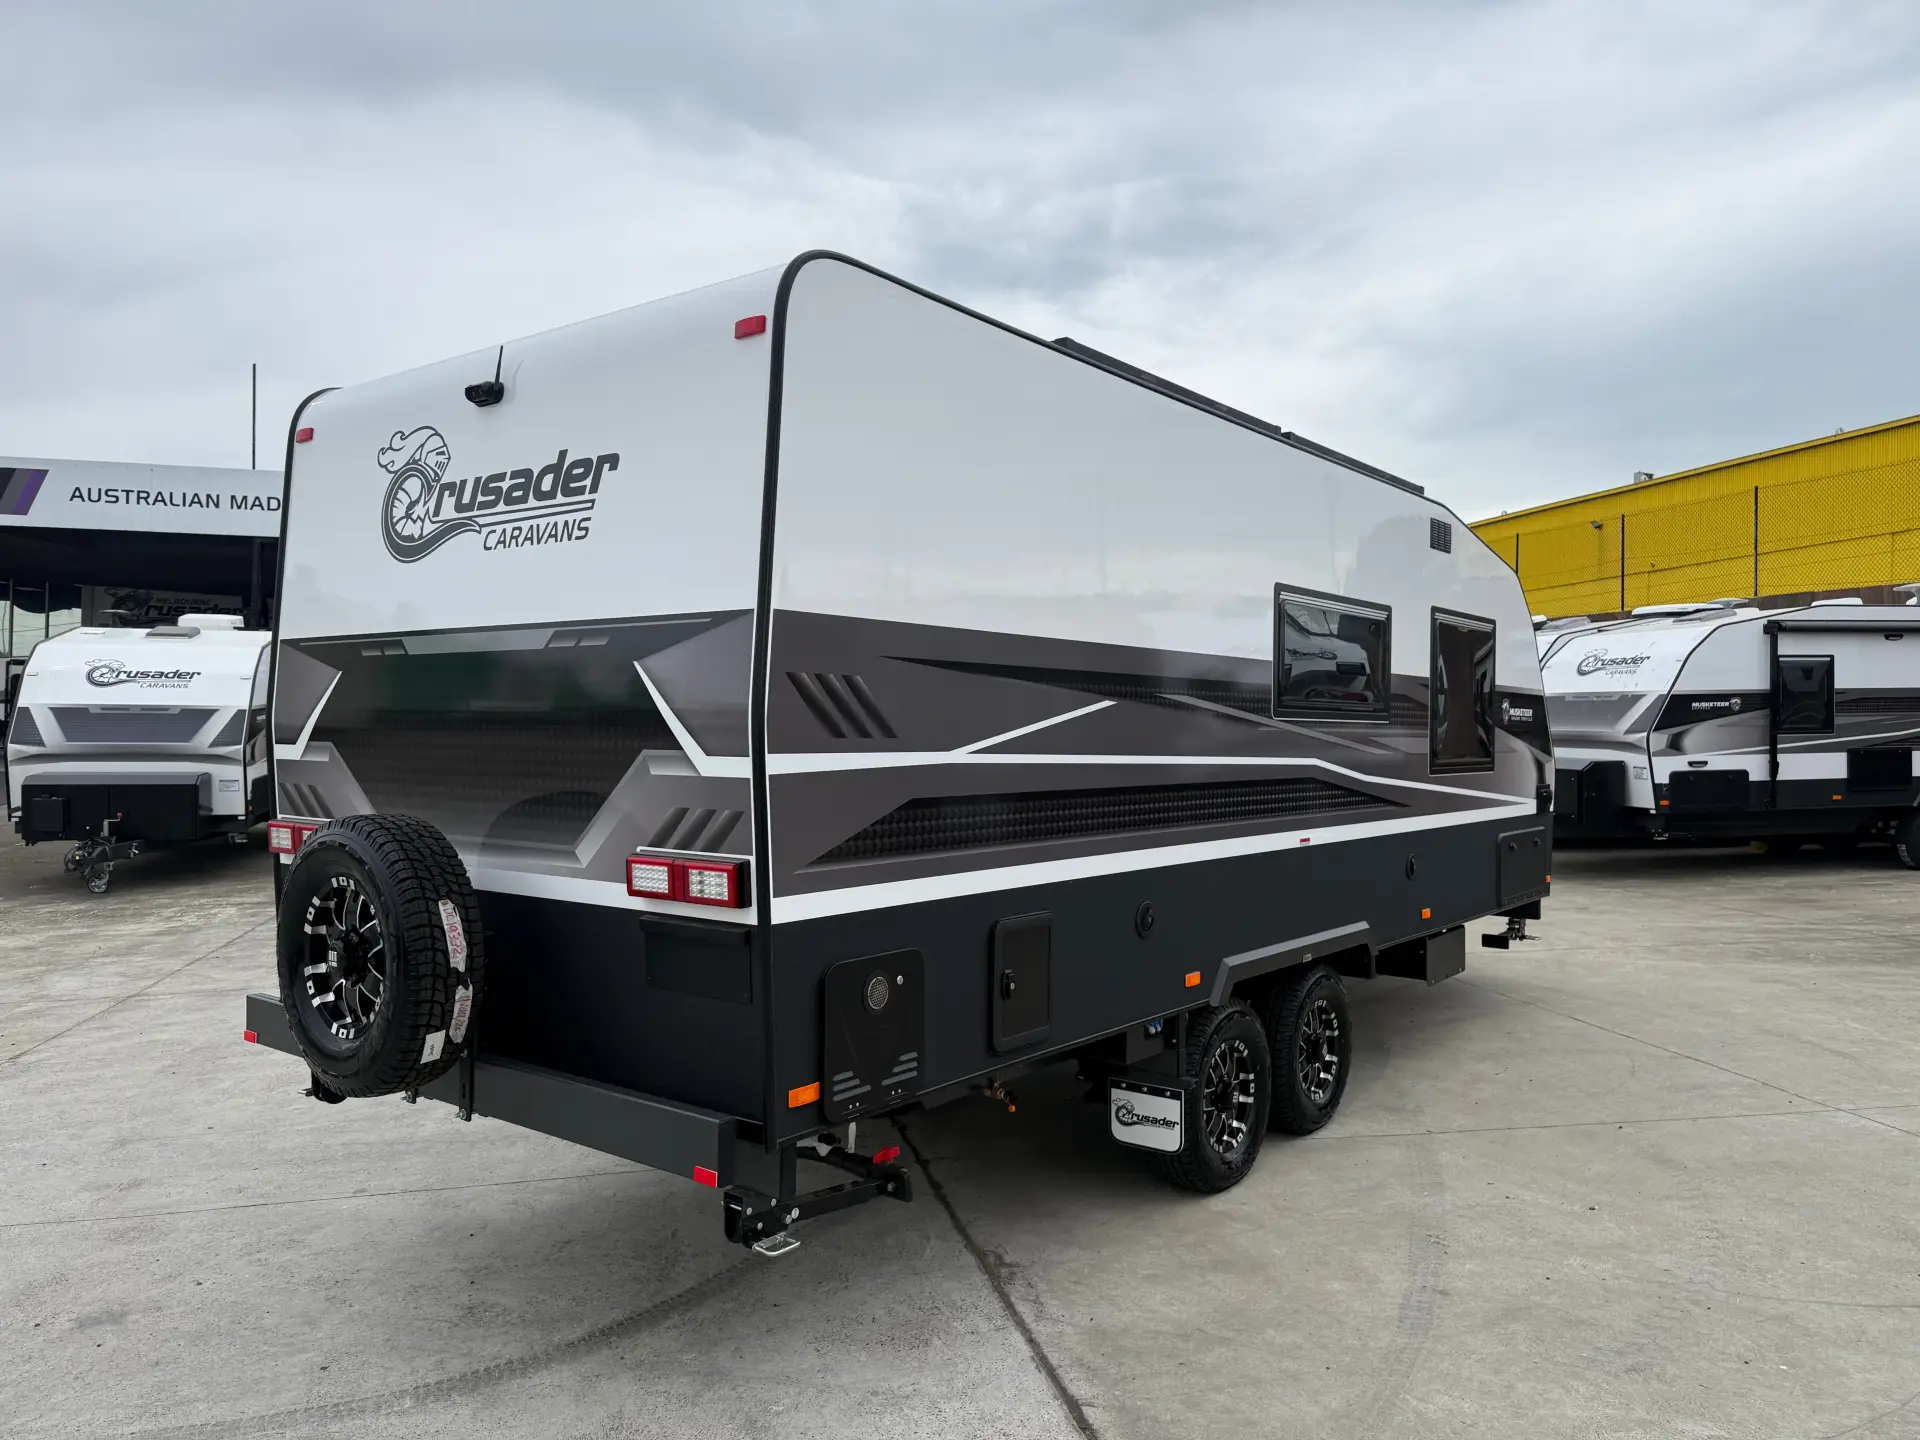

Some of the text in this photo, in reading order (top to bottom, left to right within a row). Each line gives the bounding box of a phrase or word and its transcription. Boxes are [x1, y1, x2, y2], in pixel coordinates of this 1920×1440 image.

[69, 486, 281, 512] AUSTRALIAN MAD
[379, 447, 620, 563] Crusader
[483, 516, 592, 551] CARAVANS
[155, 597, 213, 606] MELBOURNE
[85, 664, 201, 688] Crusader
[1576, 651, 1651, 676] Crusader
[1114, 1103, 1180, 1129] Crusader
